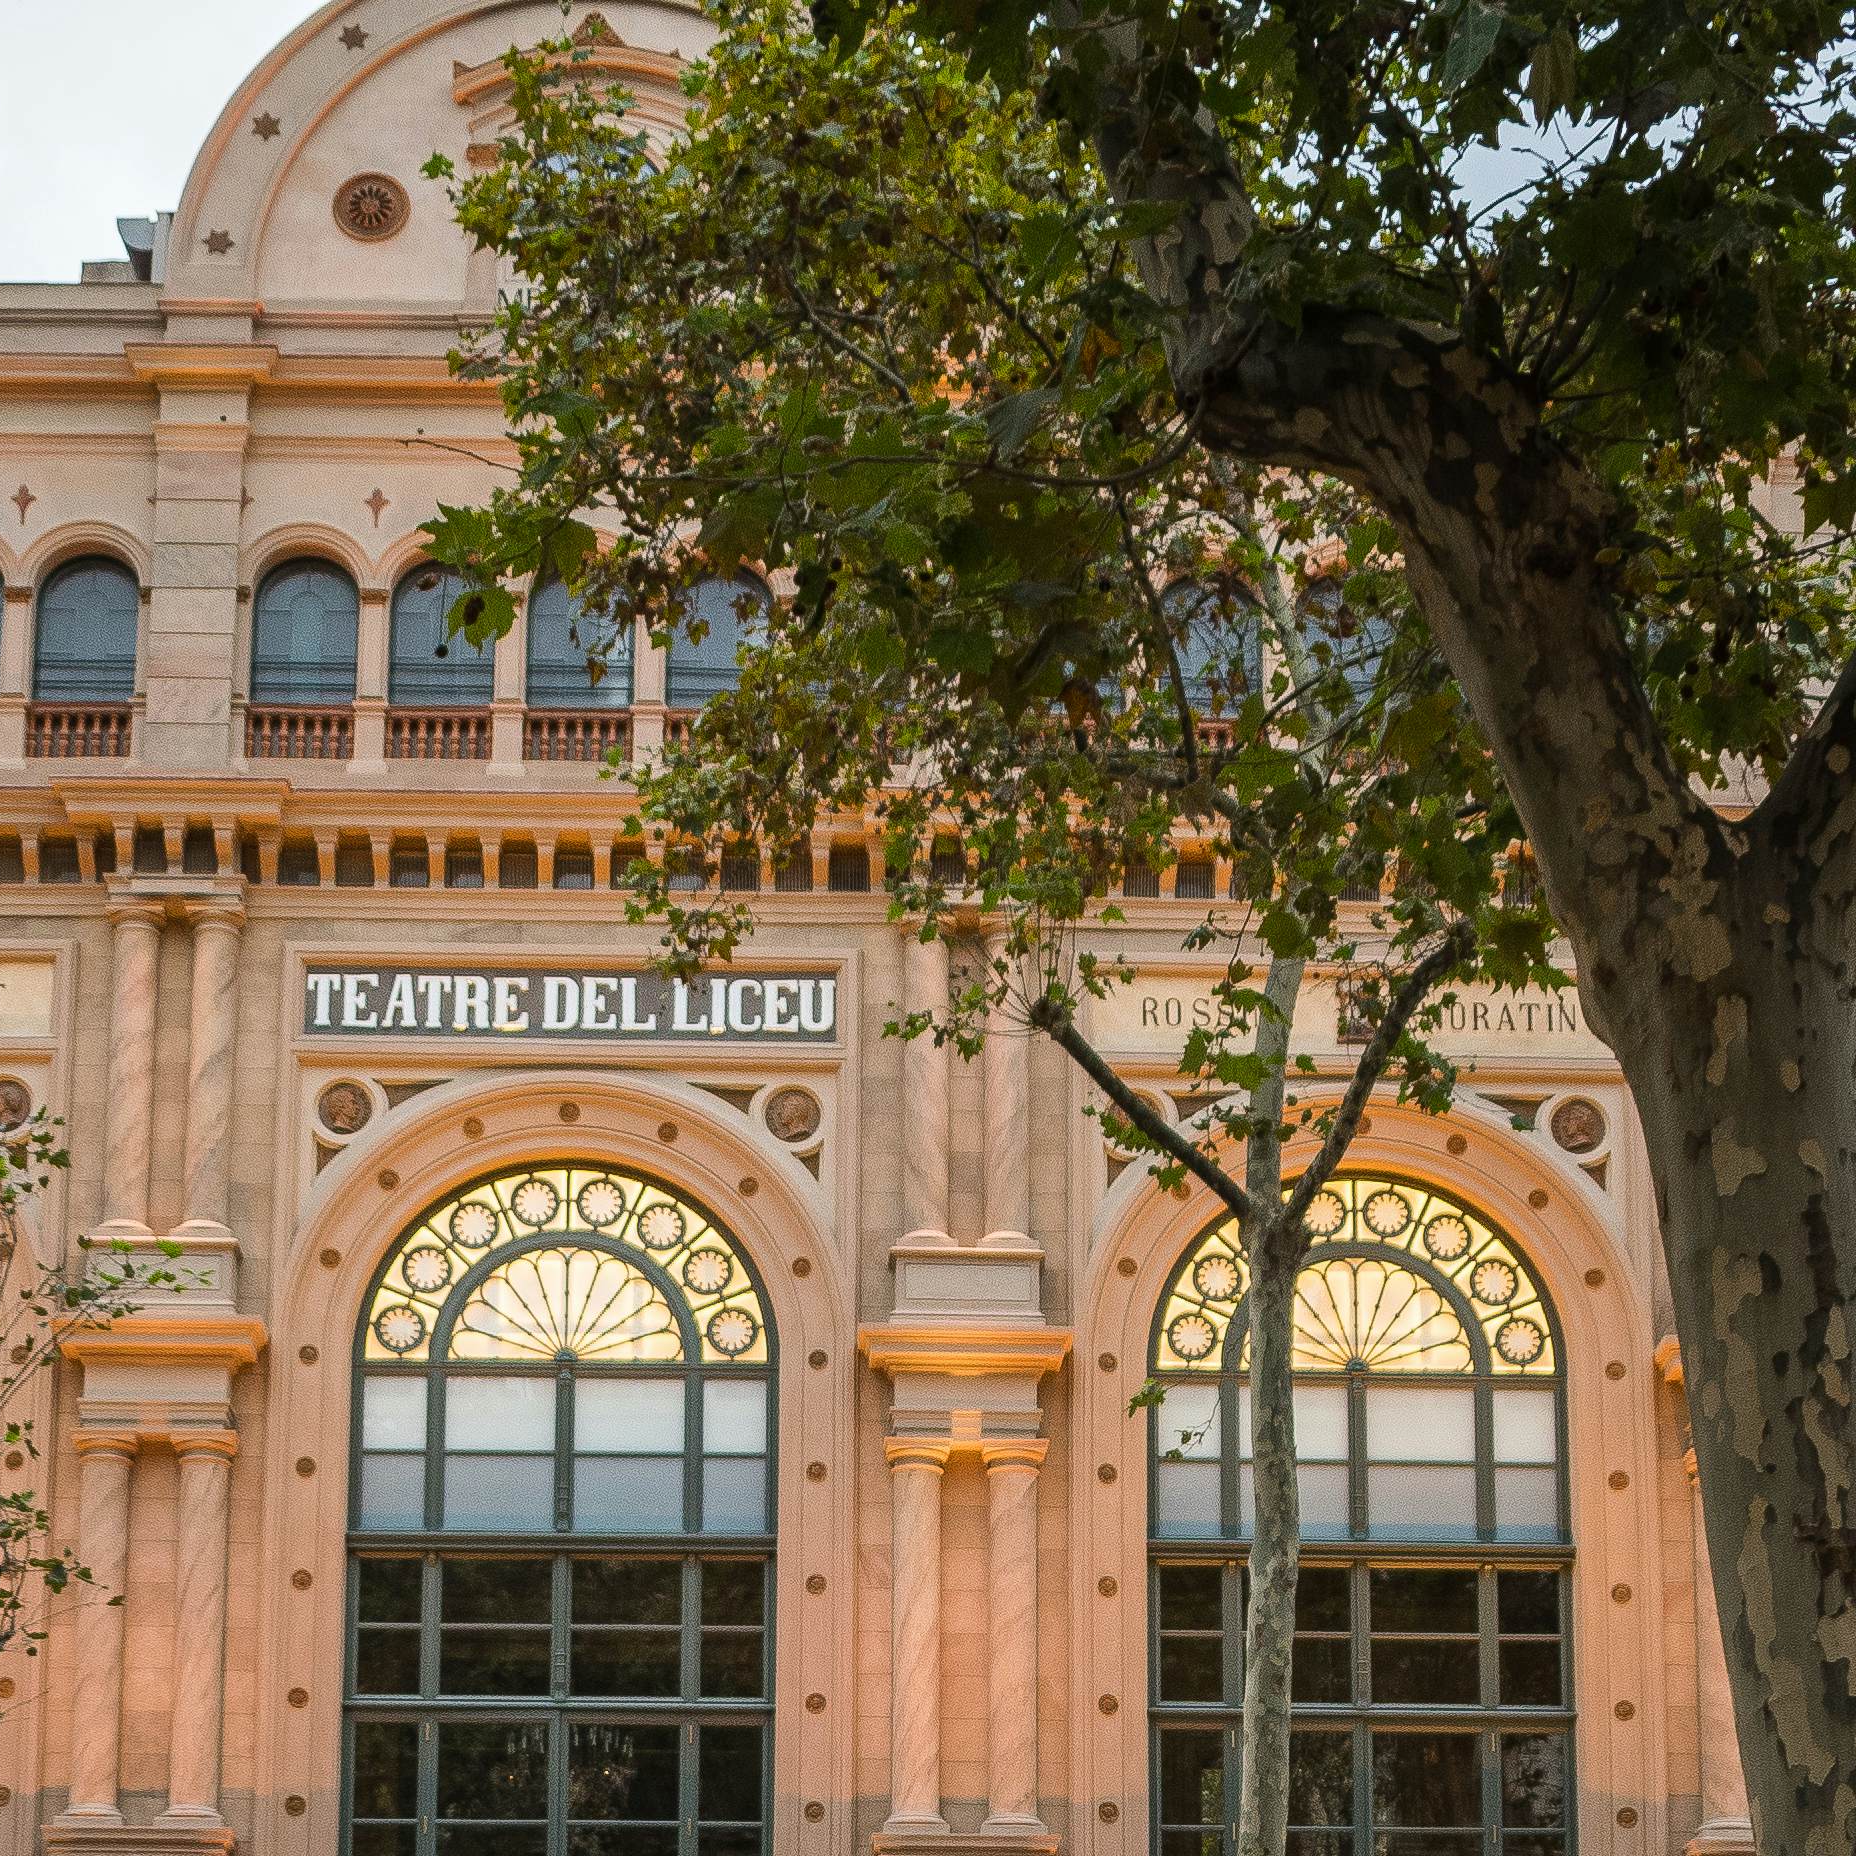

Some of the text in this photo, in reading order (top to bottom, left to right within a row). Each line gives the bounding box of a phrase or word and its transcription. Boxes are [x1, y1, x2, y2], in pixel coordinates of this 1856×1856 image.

[307, 973, 836, 1035] TEATRE DEL LICEU
[1438, 1001, 1576, 1032] ORATIN
